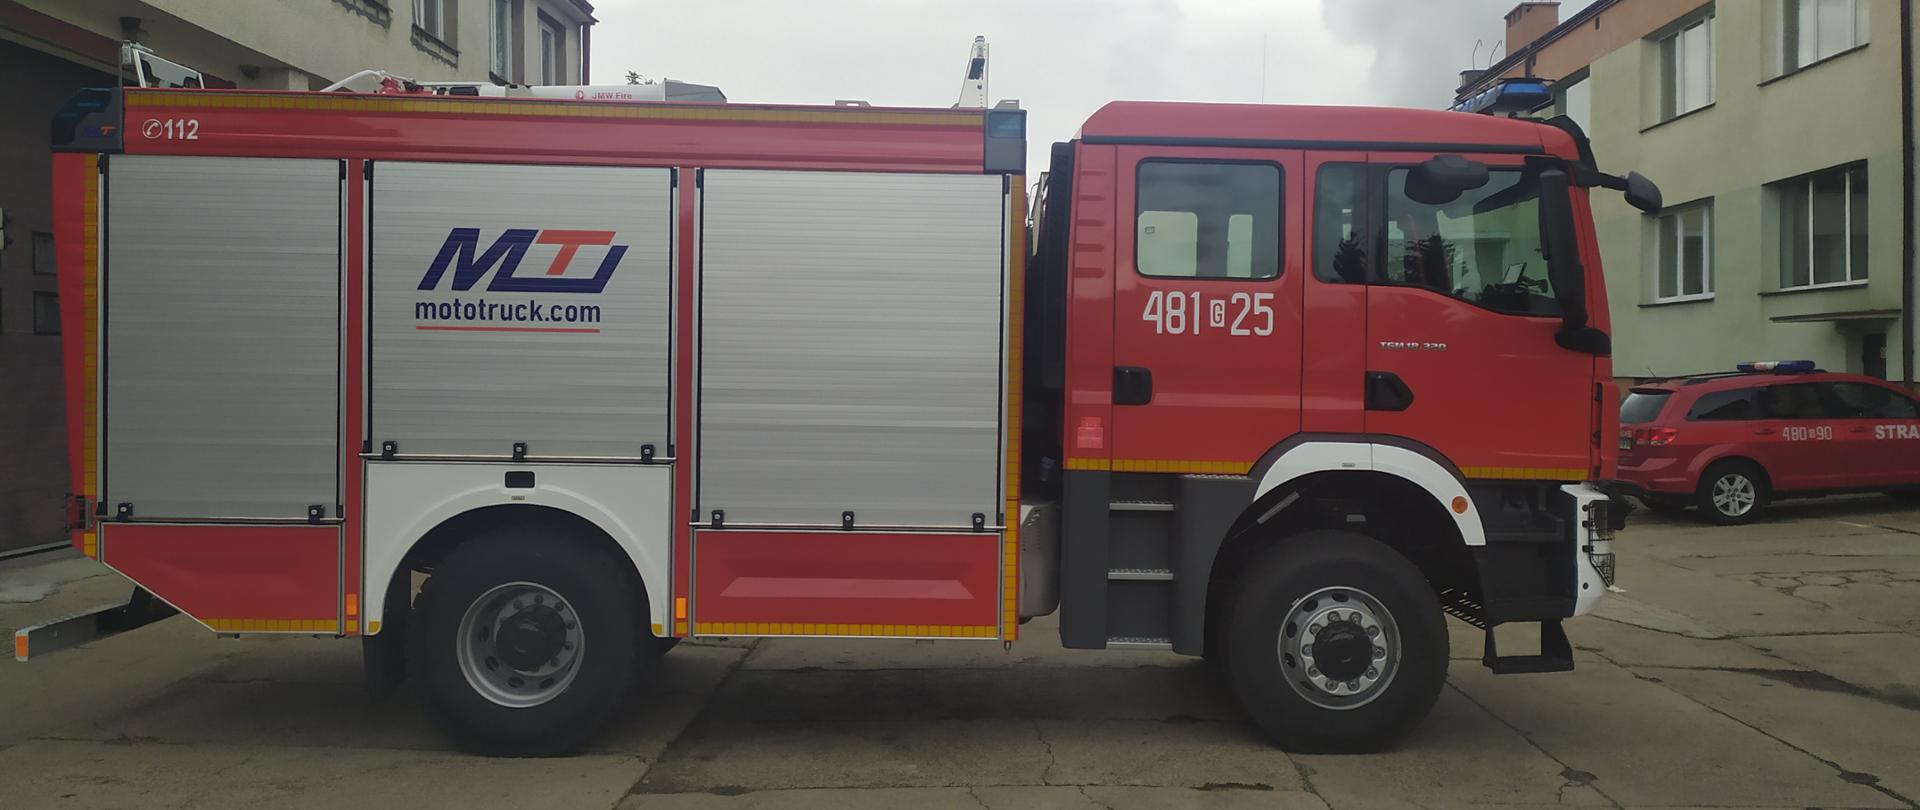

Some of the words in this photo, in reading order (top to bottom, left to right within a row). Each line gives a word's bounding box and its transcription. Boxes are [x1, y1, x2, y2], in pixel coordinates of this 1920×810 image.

[615, 91, 632, 100] Fire
[165, 119, 199, 139] 112
[415, 299, 600, 322] mototruck.com
[1142, 291, 1200, 335] 481
[1231, 292, 1274, 336] 25
[1380, 341, 1405, 350] TGM
[1874, 424, 1920, 440] STRA
